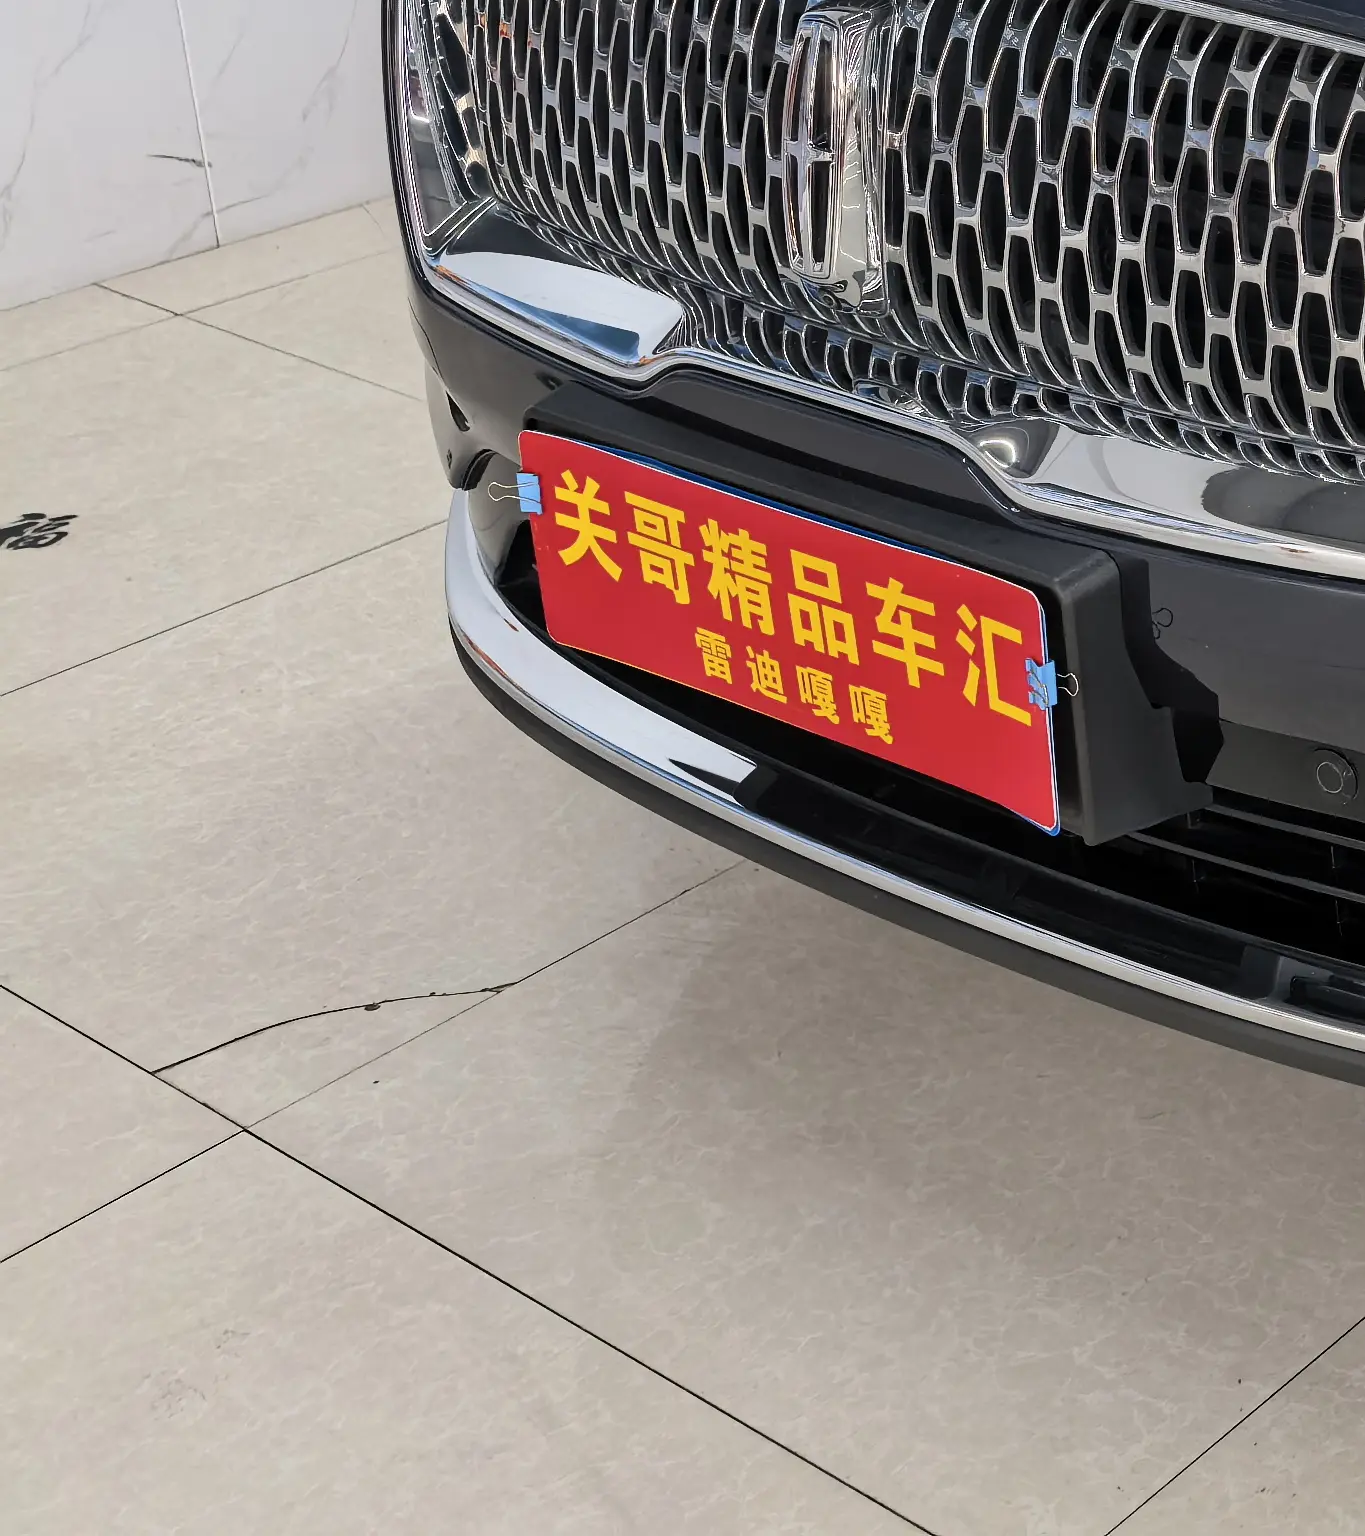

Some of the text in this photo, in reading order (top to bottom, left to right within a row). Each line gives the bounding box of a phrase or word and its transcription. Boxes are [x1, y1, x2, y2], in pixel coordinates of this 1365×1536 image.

[552, 469, 1033, 727] 关哥精品车汇
[694, 626, 895, 745] 雷迪嘎嘎
